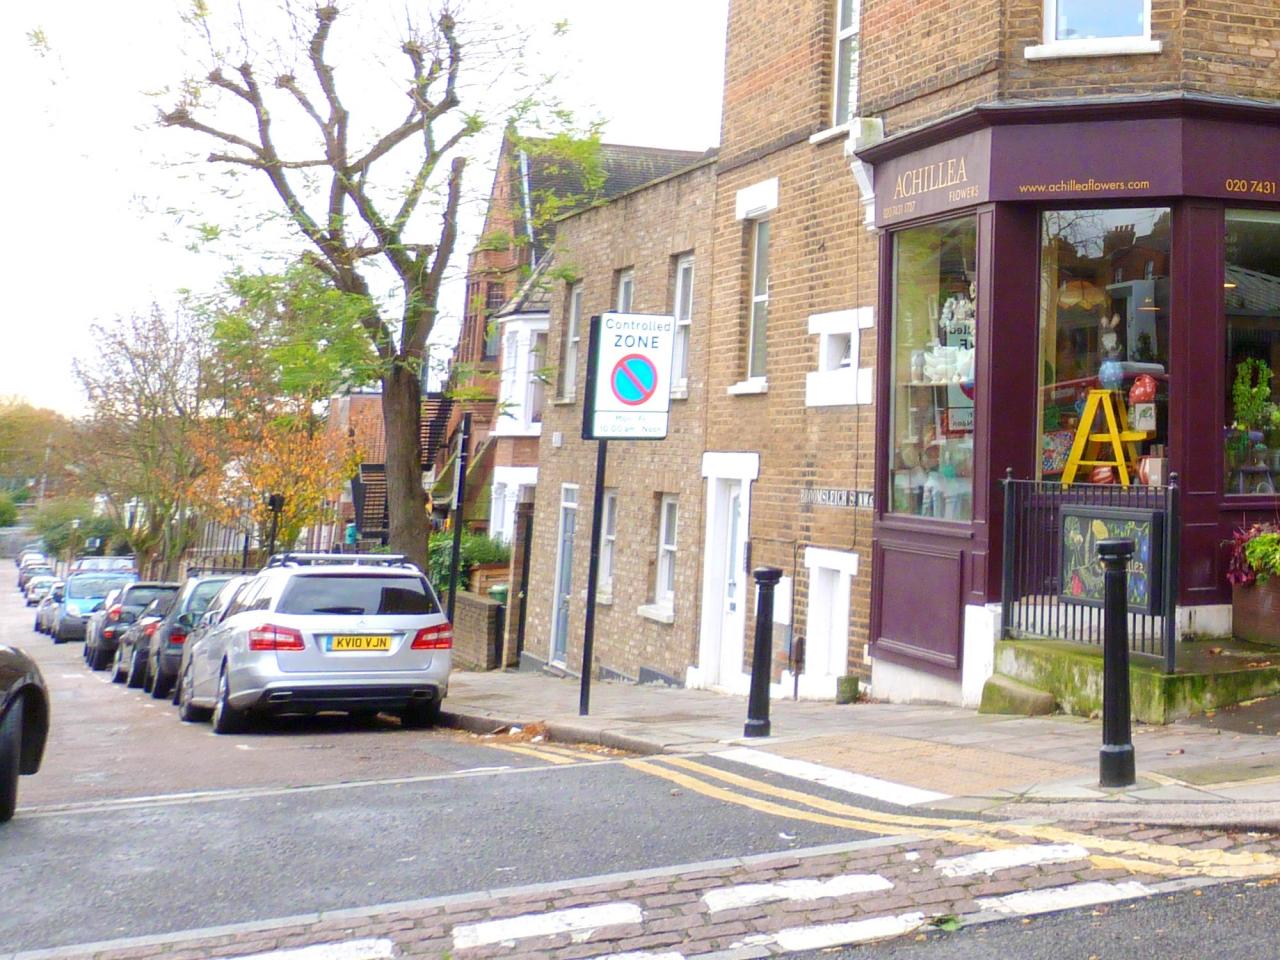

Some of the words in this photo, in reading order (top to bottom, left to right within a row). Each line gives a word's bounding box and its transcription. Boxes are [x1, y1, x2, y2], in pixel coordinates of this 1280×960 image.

[893, 156, 968, 200] ACHILLEA
[1019, 178, 1150, 193] www.achilleaflowers.com
[949, 185, 979, 202] FLOWERS
[1226, 179, 1247, 192] 020
[1250, 180, 1276, 194] 7431
[606, 318, 671, 332] Controlled
[614, 334, 659, 349] ZONE
[337, 638, 362, 648] KV10
[366, 638, 387, 648] VJN
